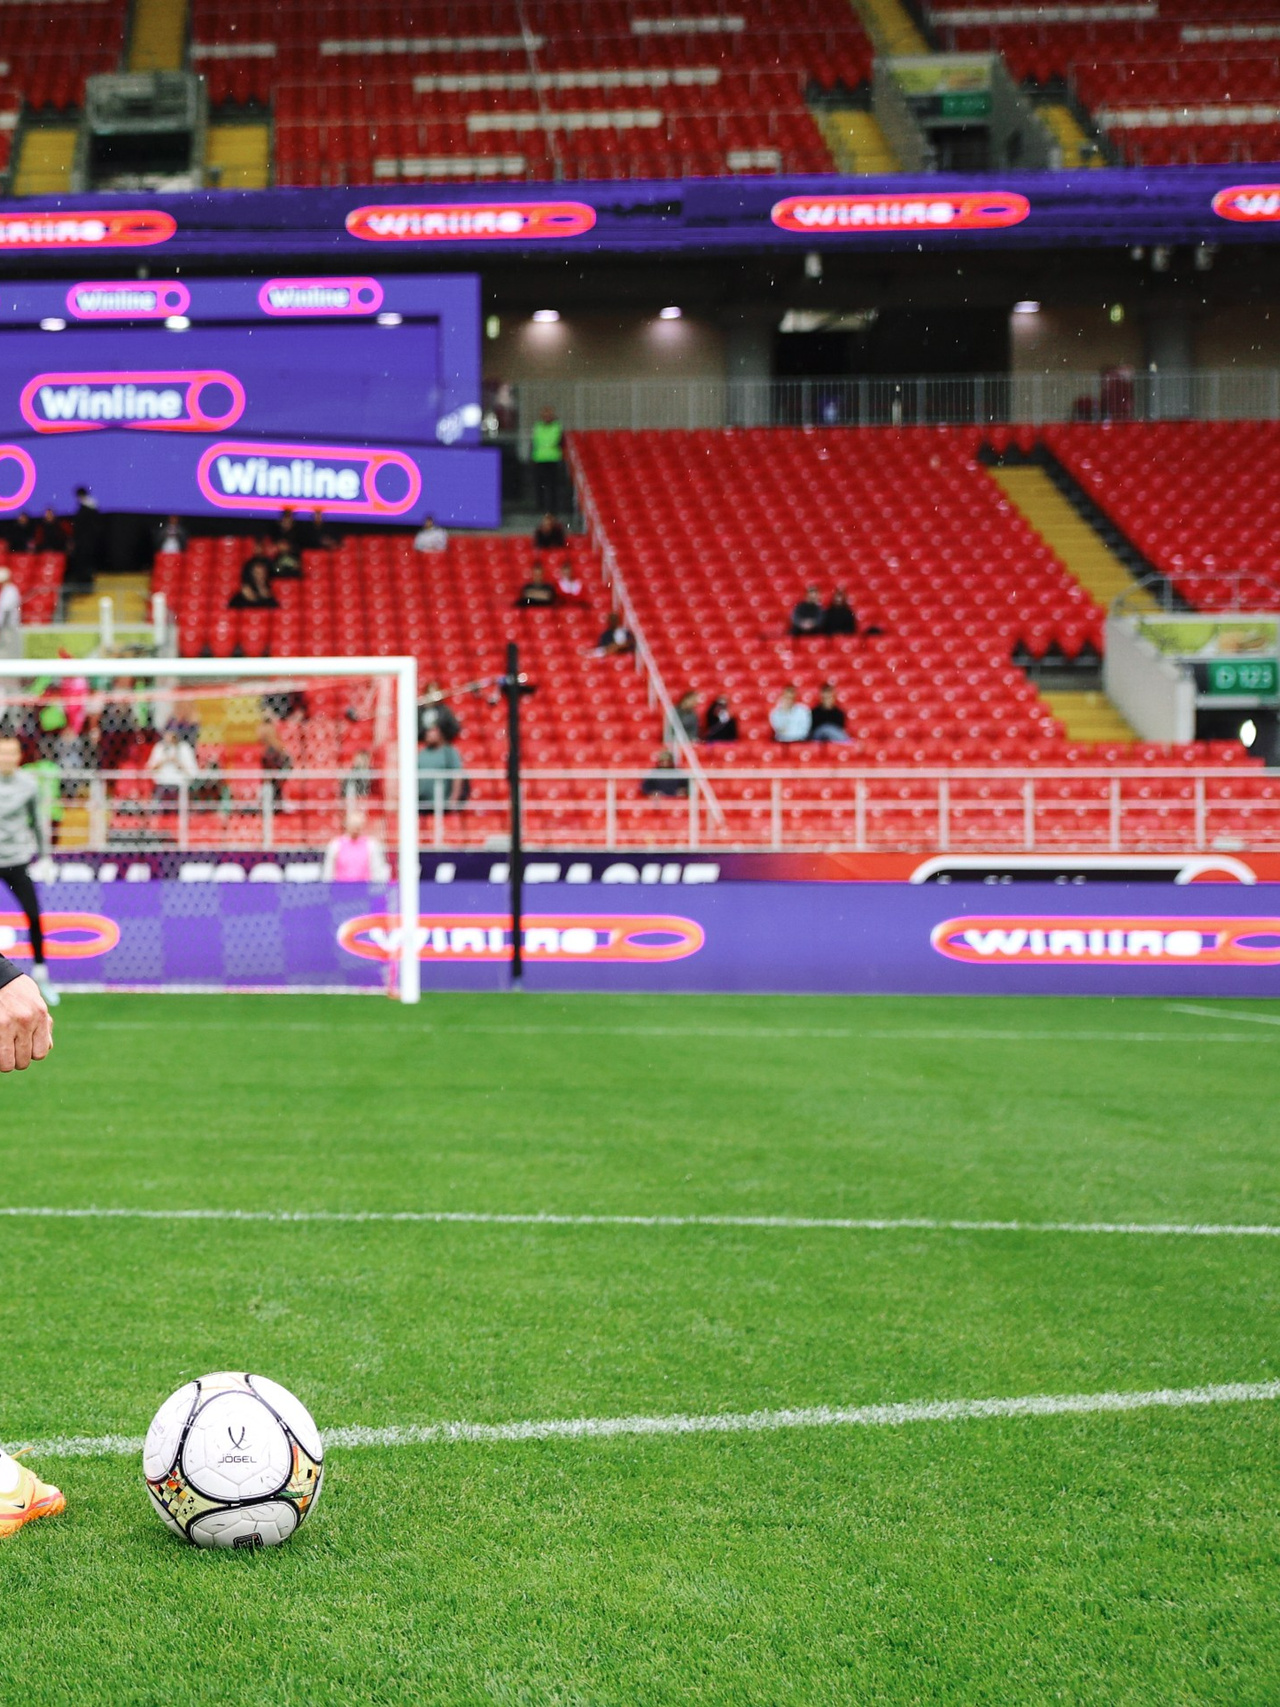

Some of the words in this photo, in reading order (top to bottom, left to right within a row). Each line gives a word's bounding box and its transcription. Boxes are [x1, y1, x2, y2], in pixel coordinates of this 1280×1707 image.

[39, 383, 184, 420] Winline
[216, 455, 361, 500] Winline
[963, 929, 1203, 957] Winline
[218, 1453, 257, 1463] JÖGEL
